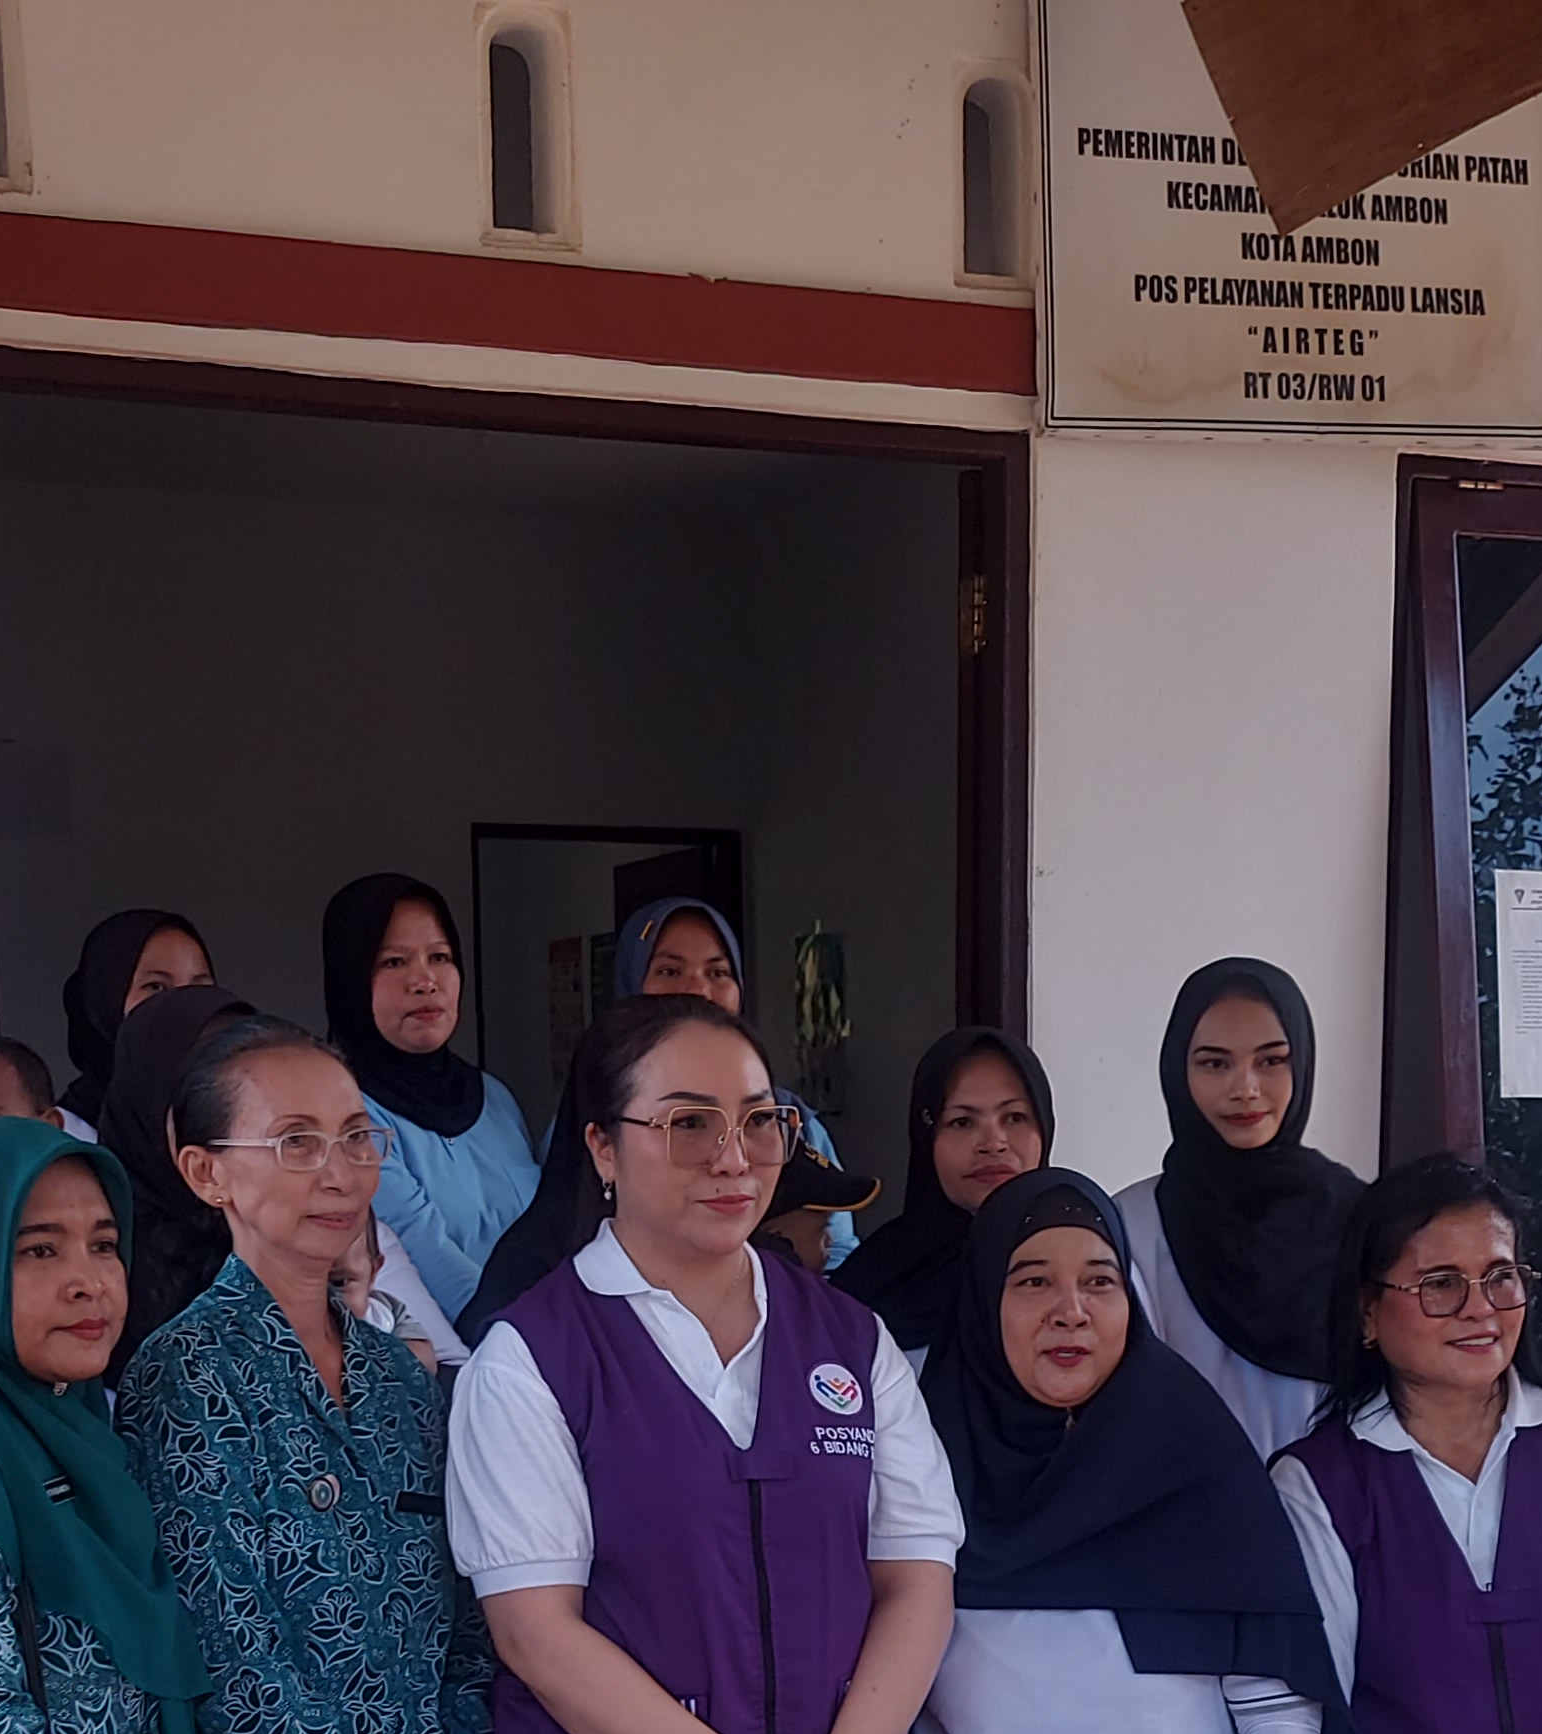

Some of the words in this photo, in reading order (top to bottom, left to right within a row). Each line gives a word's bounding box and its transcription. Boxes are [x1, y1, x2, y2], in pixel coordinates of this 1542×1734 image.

[1077, 127, 1216, 165] PEMERINTAH
[1464, 155, 1529, 186] PATAH
[1371, 194, 1448, 225] AMBON
[1241, 232, 1297, 262] KOTA
[1301, 236, 1380, 267] AMBON
[1134, 274, 1178, 304] POS
[1184, 276, 1304, 309] PELAYANAN
[1308, 281, 1405, 313] TERPADU
[1410, 286, 1487, 316] LANSIA
[1243, 371, 1272, 400] RT
[1277, 372, 1356, 402] 03/RW
[1361, 375, 1386, 402] 01
[810, 1441, 820, 1455] 6
[823, 1441, 869, 1458] BIDANG
[814, 1426, 875, 1444] POSYAND
